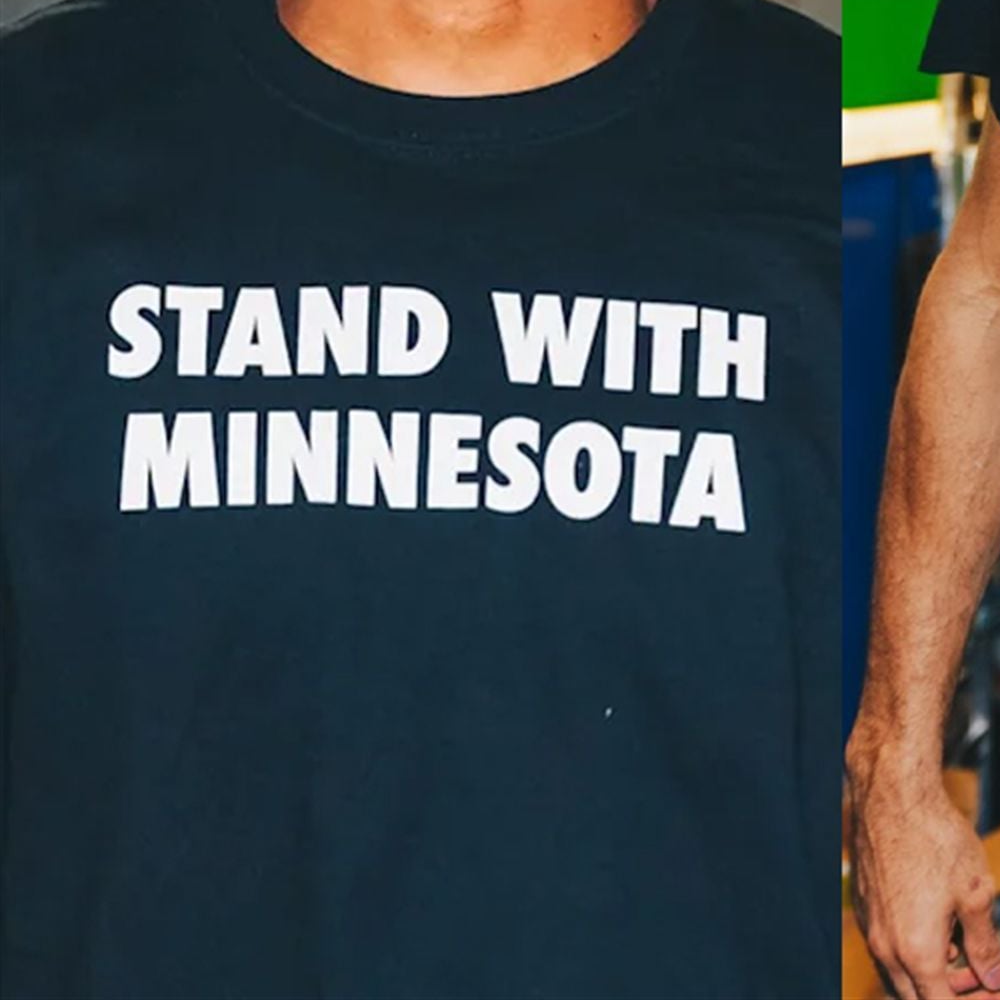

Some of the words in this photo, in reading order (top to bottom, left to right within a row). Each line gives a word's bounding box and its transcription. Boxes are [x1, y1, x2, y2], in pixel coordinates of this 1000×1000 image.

[108, 284, 450, 379] STAND
[491, 291, 767, 402] WITH
[119, 409, 746, 533] MINNESOTA
